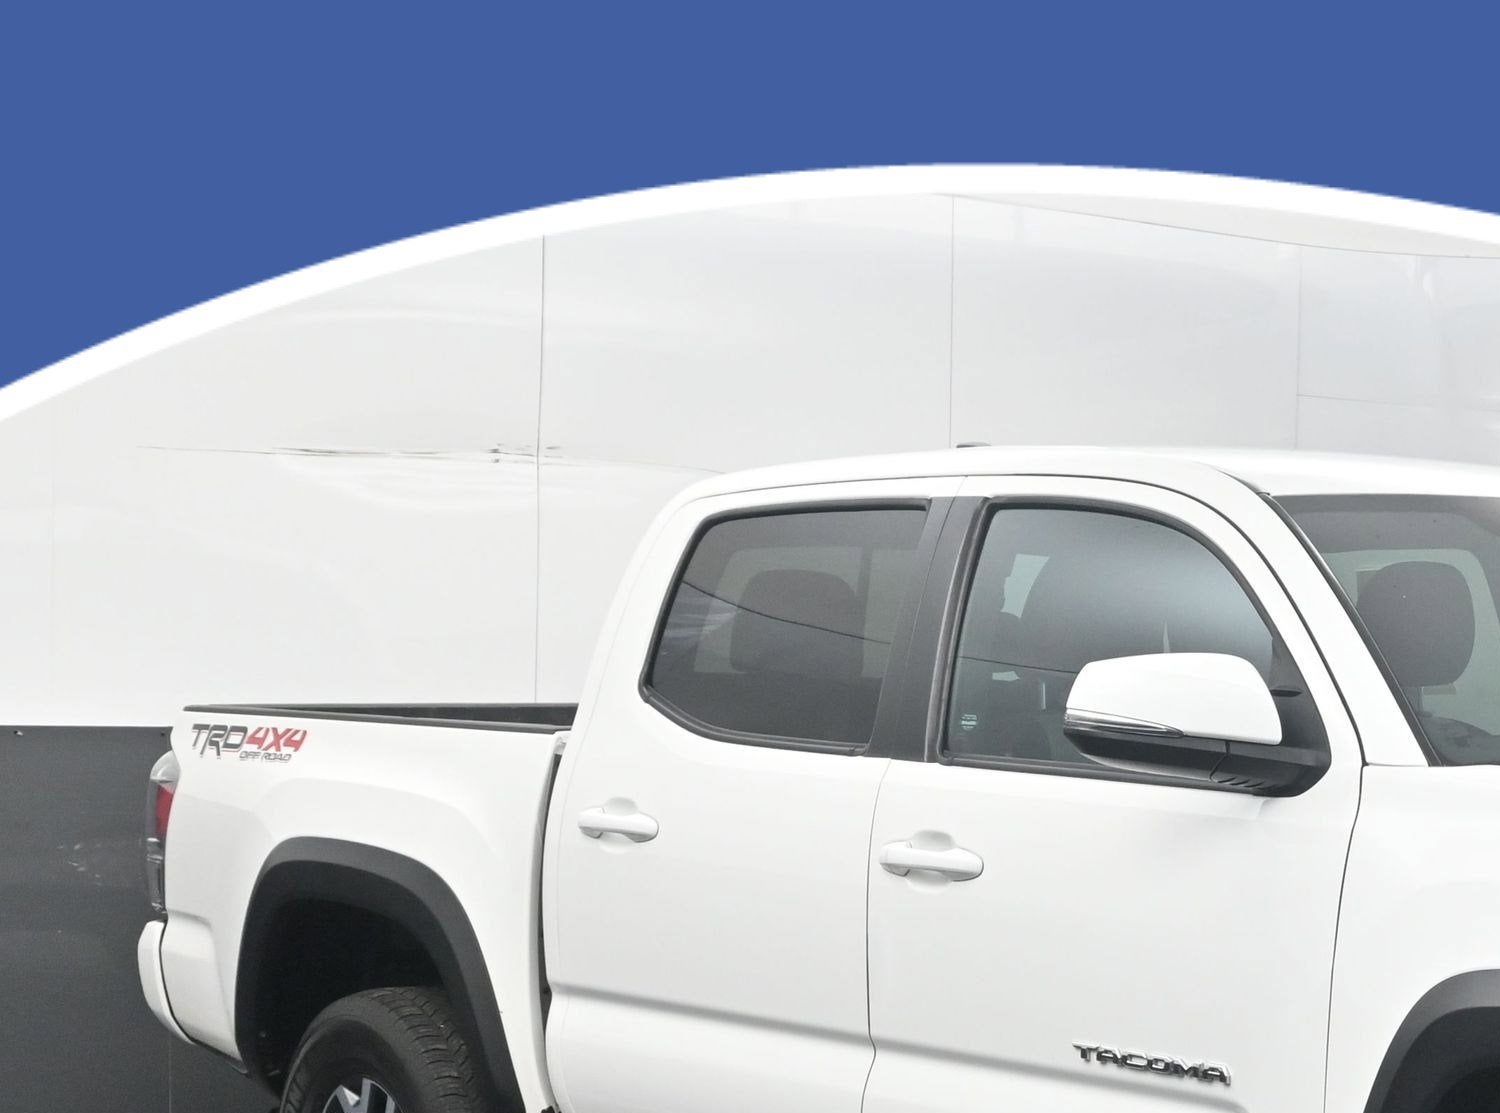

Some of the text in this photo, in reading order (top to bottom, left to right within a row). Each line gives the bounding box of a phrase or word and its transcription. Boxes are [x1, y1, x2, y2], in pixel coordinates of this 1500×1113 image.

[192, 723, 248, 758] TRD
[239, 750, 292, 762] OFF ROAD
[1071, 1041, 1232, 1086] TACOMA
